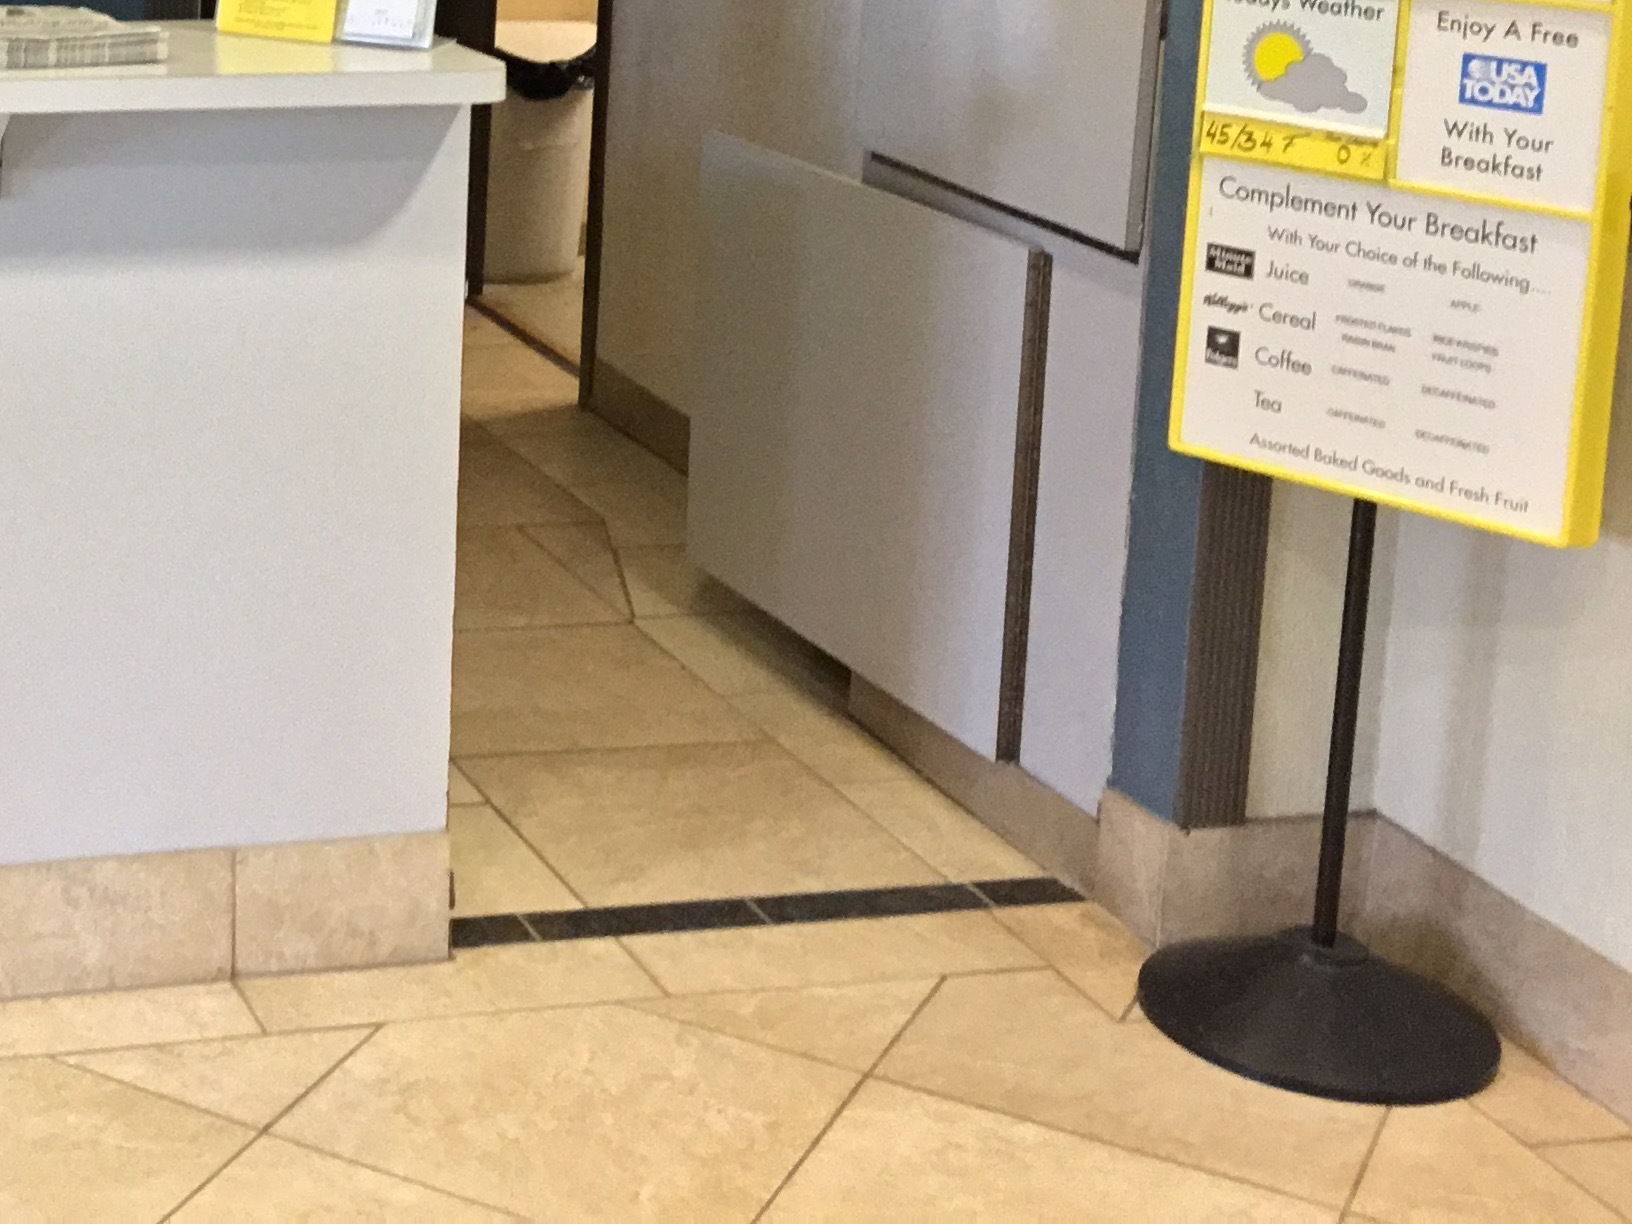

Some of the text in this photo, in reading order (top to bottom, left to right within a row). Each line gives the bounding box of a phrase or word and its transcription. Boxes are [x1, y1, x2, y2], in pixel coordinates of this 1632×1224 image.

[1436, 11, 1580, 49] Enjoy A Free
[1489, 58, 1538, 86] USA
[1462, 77, 1543, 109] TODAY
[1443, 118, 1554, 154] With Your
[1441, 147, 1543, 182] Breakfast
[1219, 176, 1538, 255] Complement Your Breakfast
[1268, 226, 1302, 247] With
[1308, 233, 1339, 254] Your
[1346, 239, 1398, 266] Choice
[1403, 249, 1420, 270] of
[1424, 253, 1447, 275] the
[1265, 261, 1310, 286] Juice
[1258, 303, 1316, 332] Cereal
[1254, 347, 1312, 376] Coffee
[1254, 390, 1282, 414] Tea
[1249, 433, 1529, 514] Assorted Baked Goods and Fresh Fruit
